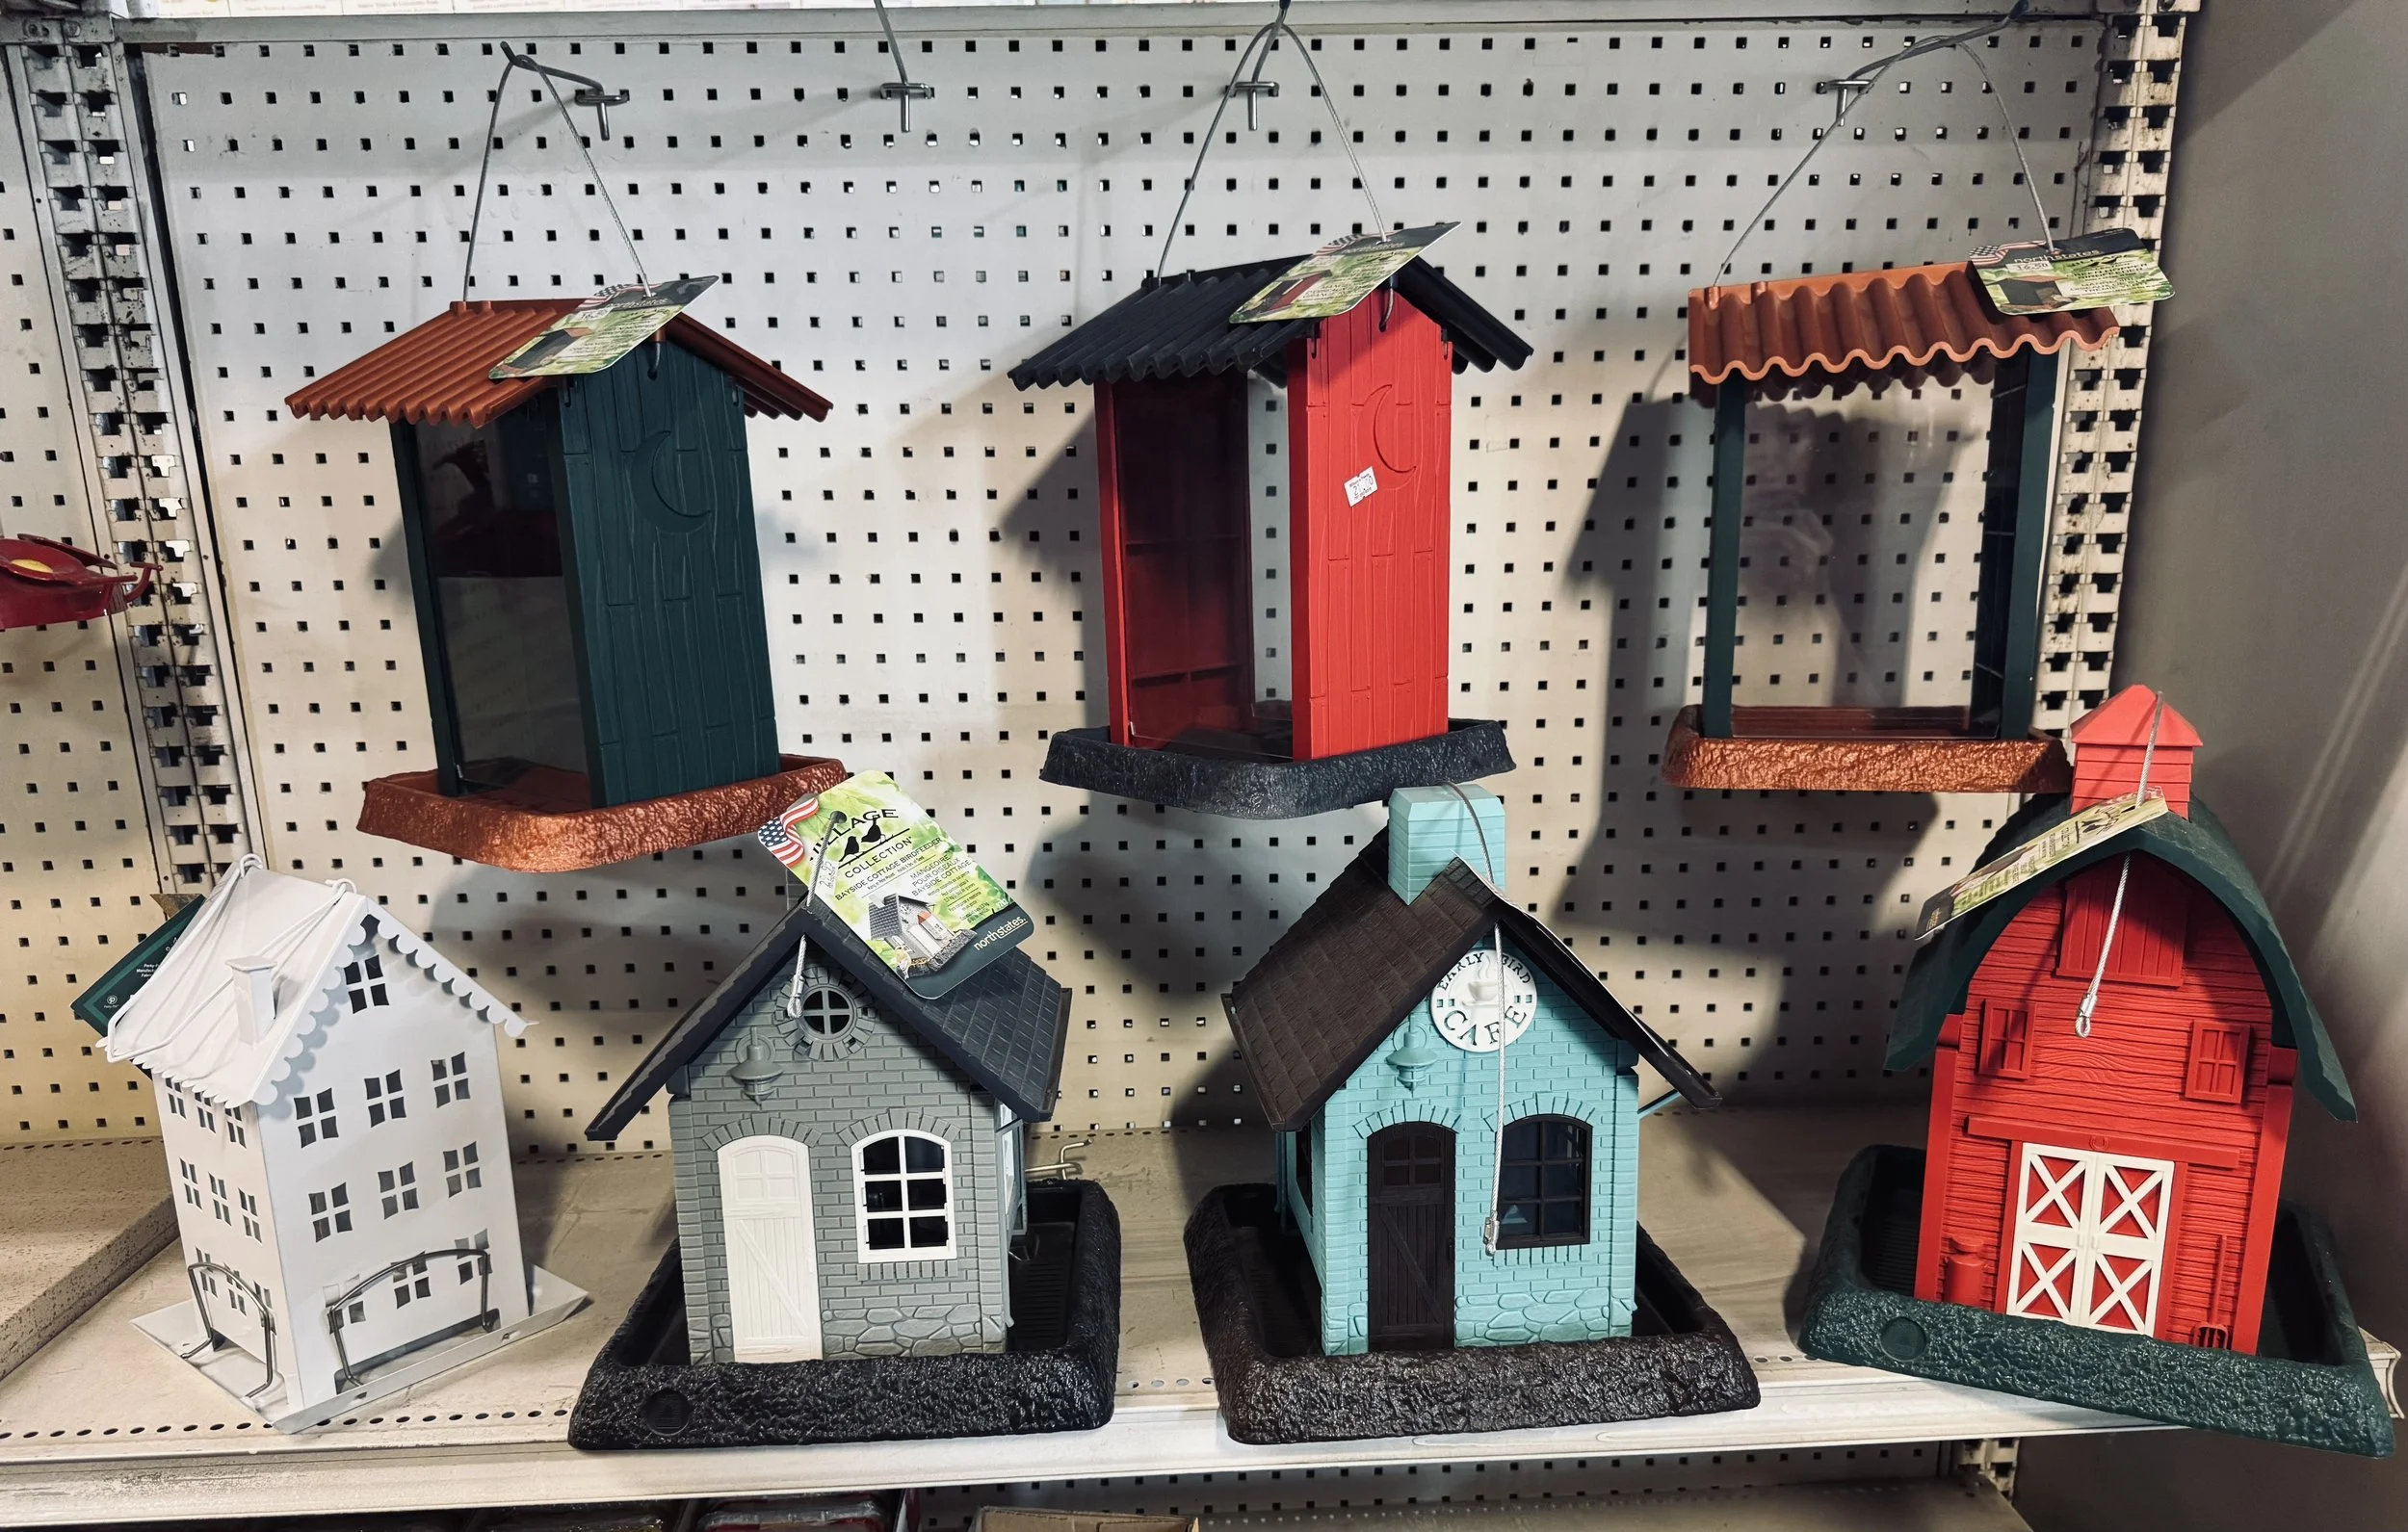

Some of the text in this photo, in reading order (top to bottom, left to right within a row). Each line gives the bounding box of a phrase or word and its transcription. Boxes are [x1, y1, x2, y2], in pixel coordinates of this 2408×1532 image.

[835, 837, 942, 901] BAYSIDE COTTAGE BIRDFEEDER
[845, 838, 912, 878] COLLECTION
[910, 854, 951, 879] MANGEOIRE
[911, 878, 942, 896] BAYSIDE
[941, 859, 971, 879] COTTAGE
[912, 873, 932, 888] POUR
[931, 857, 961, 876] OISEAUX
[1437, 951, 1531, 991] EARLY BIRD
[1444, 1005, 1527, 1046] CAFE
